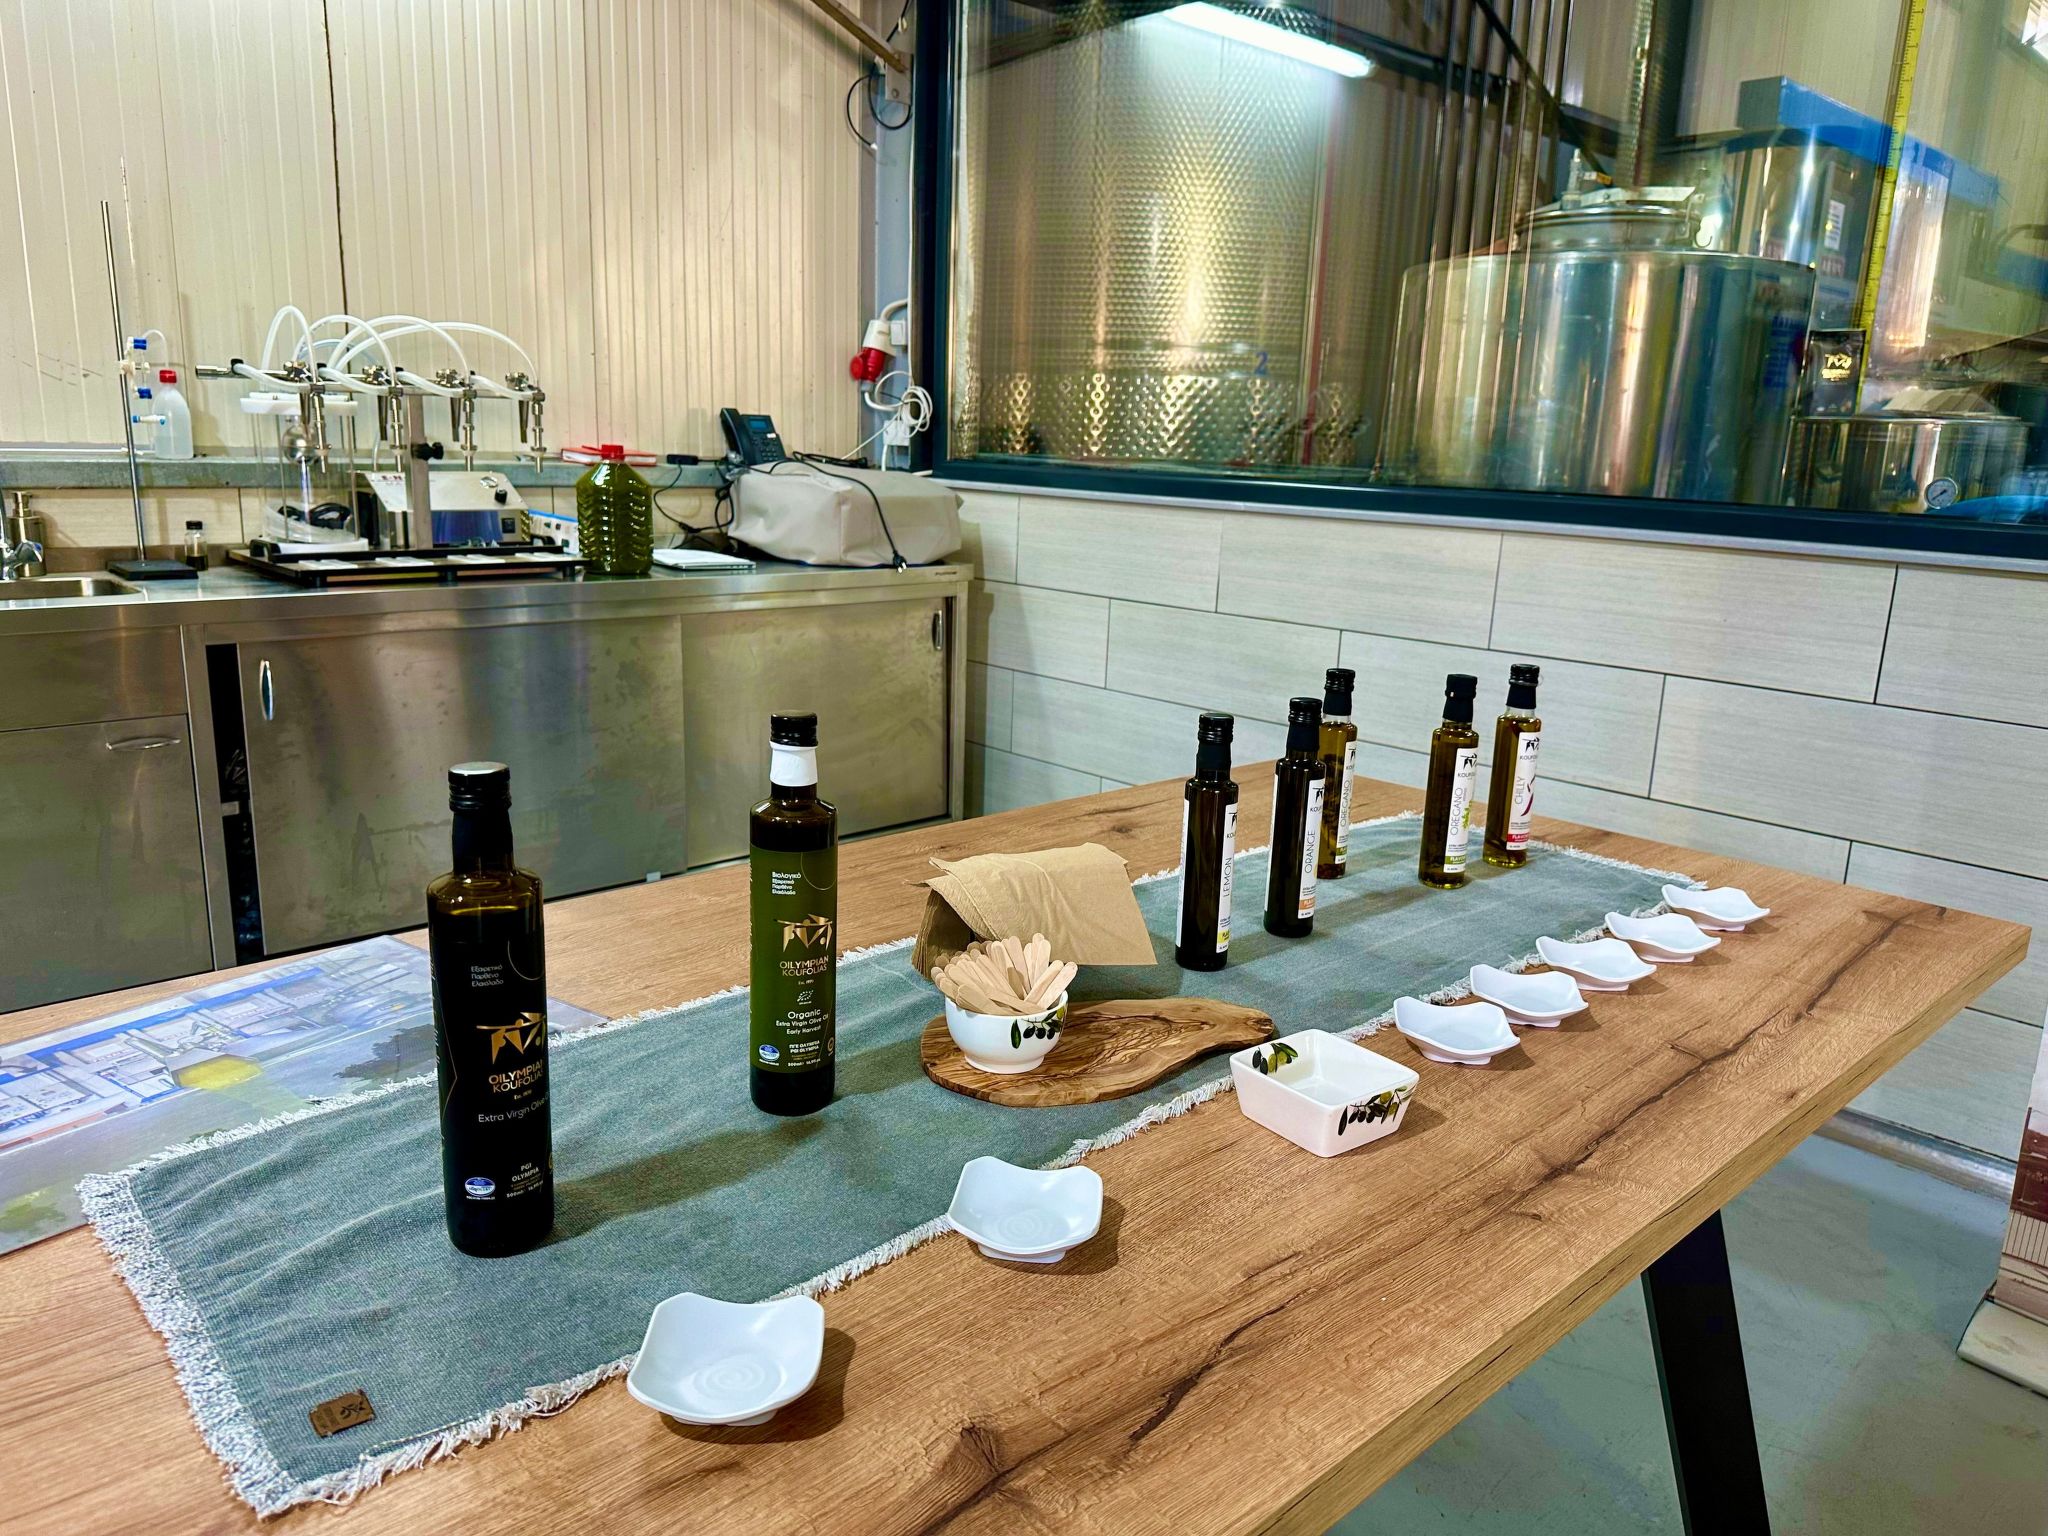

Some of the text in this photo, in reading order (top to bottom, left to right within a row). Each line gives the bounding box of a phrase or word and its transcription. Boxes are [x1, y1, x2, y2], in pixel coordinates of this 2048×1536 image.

[1254, 351, 1267, 375] 2
[1515, 776, 1526, 805] CHILLY
[1340, 781, 1350, 827] OREGANO
[1450, 787, 1463, 836] OREGANO
[1304, 830, 1316, 874] ORANGE
[1223, 857, 1232, 897] LEMON
[780, 955, 829, 969] OILYMPIAN
[782, 963, 827, 976] KOUFOLIAS
[787, 1008, 821, 1020] Organic
[791, 1019, 807, 1028] Virgin
[808, 1016, 821, 1025] Olive
[802, 1025, 822, 1033] Harvest
[478, 1114, 504, 1122] Extra
[506, 1105, 530, 1118] Virgin
[511, 1167, 540, 1182] OLYMPIA
[520, 1162, 532, 1171] PGI
